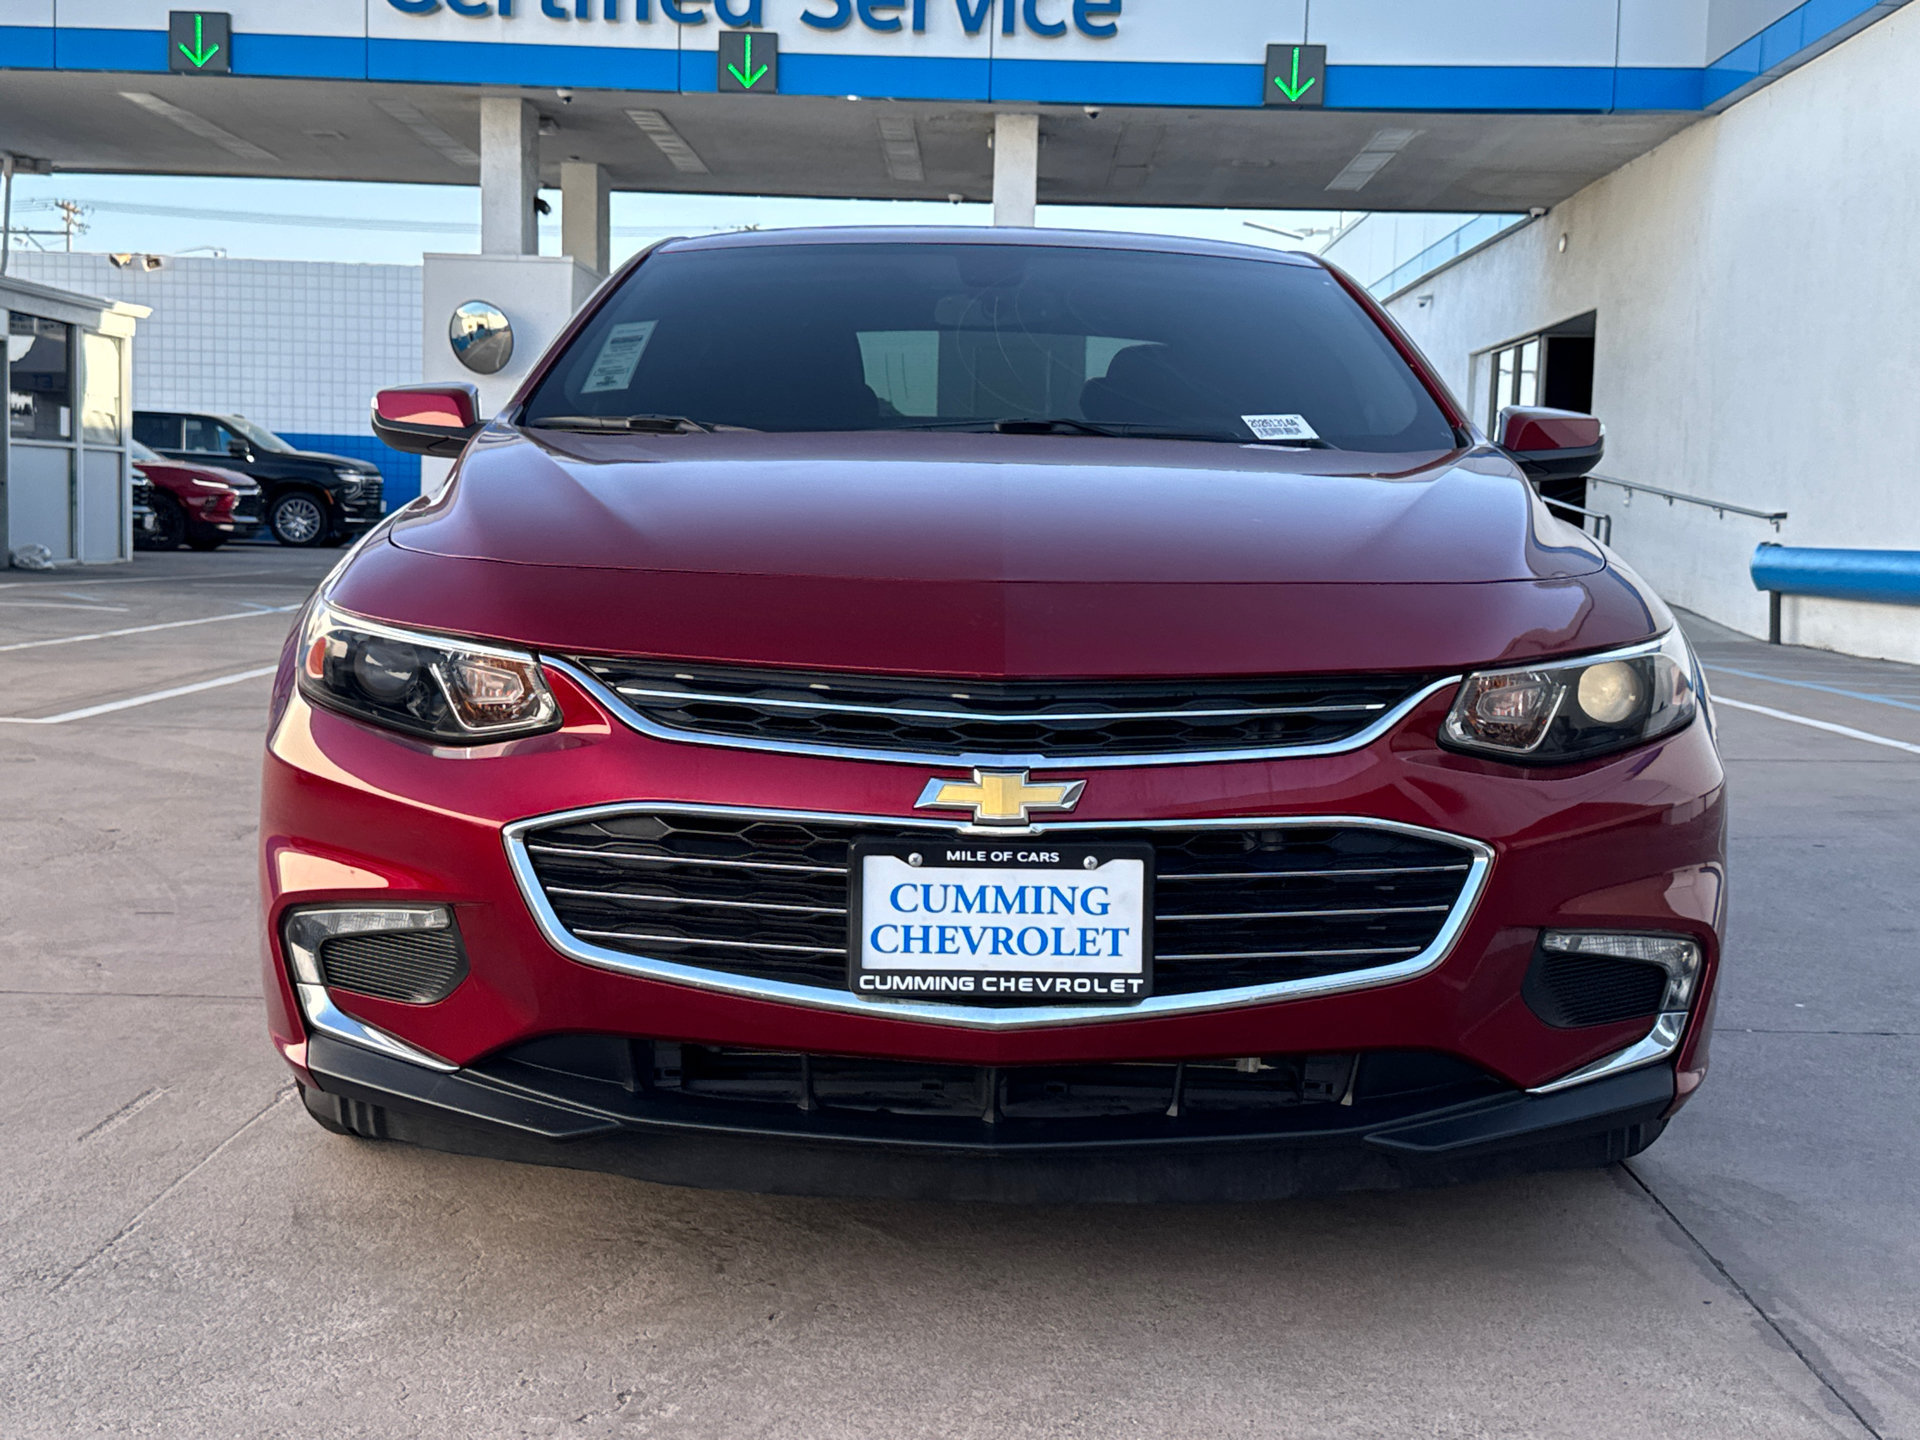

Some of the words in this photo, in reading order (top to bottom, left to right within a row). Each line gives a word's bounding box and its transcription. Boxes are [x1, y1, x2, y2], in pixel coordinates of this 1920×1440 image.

[946, 851, 989, 862] MILE
[991, 851, 1014, 862] OF
[1016, 852, 1060, 863] CARS
[890, 883, 1111, 916] CUMMING
[870, 924, 1130, 957] CHEVROLET
[859, 975, 975, 991] CUMMING
[981, 976, 1144, 993] CHEVROLET
